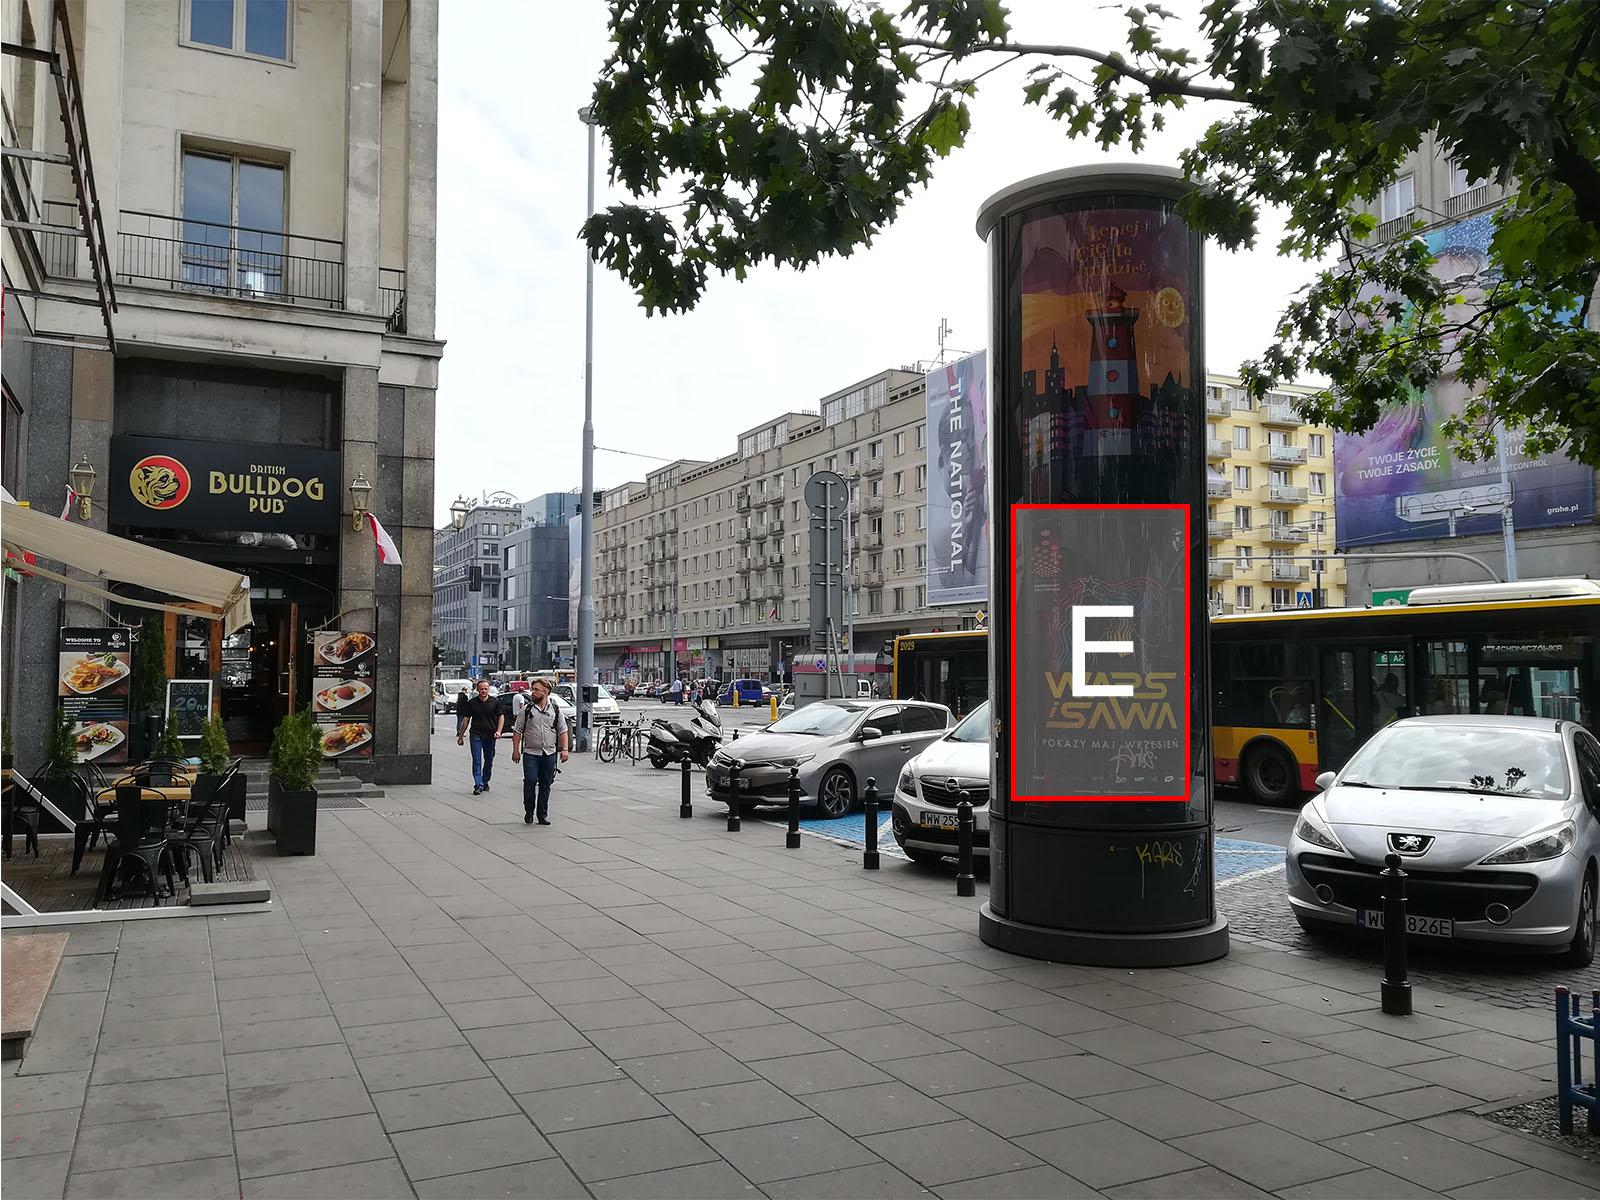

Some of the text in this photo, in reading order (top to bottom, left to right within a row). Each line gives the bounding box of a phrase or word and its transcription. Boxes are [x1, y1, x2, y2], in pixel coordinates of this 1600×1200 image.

[1368, 446, 1441, 466] TWOJE ŻYCIE.
[250, 464, 286, 475] BRITISH
[949, 377, 963, 573] THE NATIONAL
[1358, 459, 1441, 480] TWOJE ZASADY.
[1463, 466, 1487, 478] GROHE
[209, 471, 324, 501] BULLDOG
[249, 497, 285, 514] PUB
[1547, 503, 1580, 516] grohe.pl
[1042, 739, 1087, 749] POKAZY
[1091, 740, 1116, 749] MAJ
[943, 816, 960, 827] 255
[1407, 917, 1451, 937] 826E
